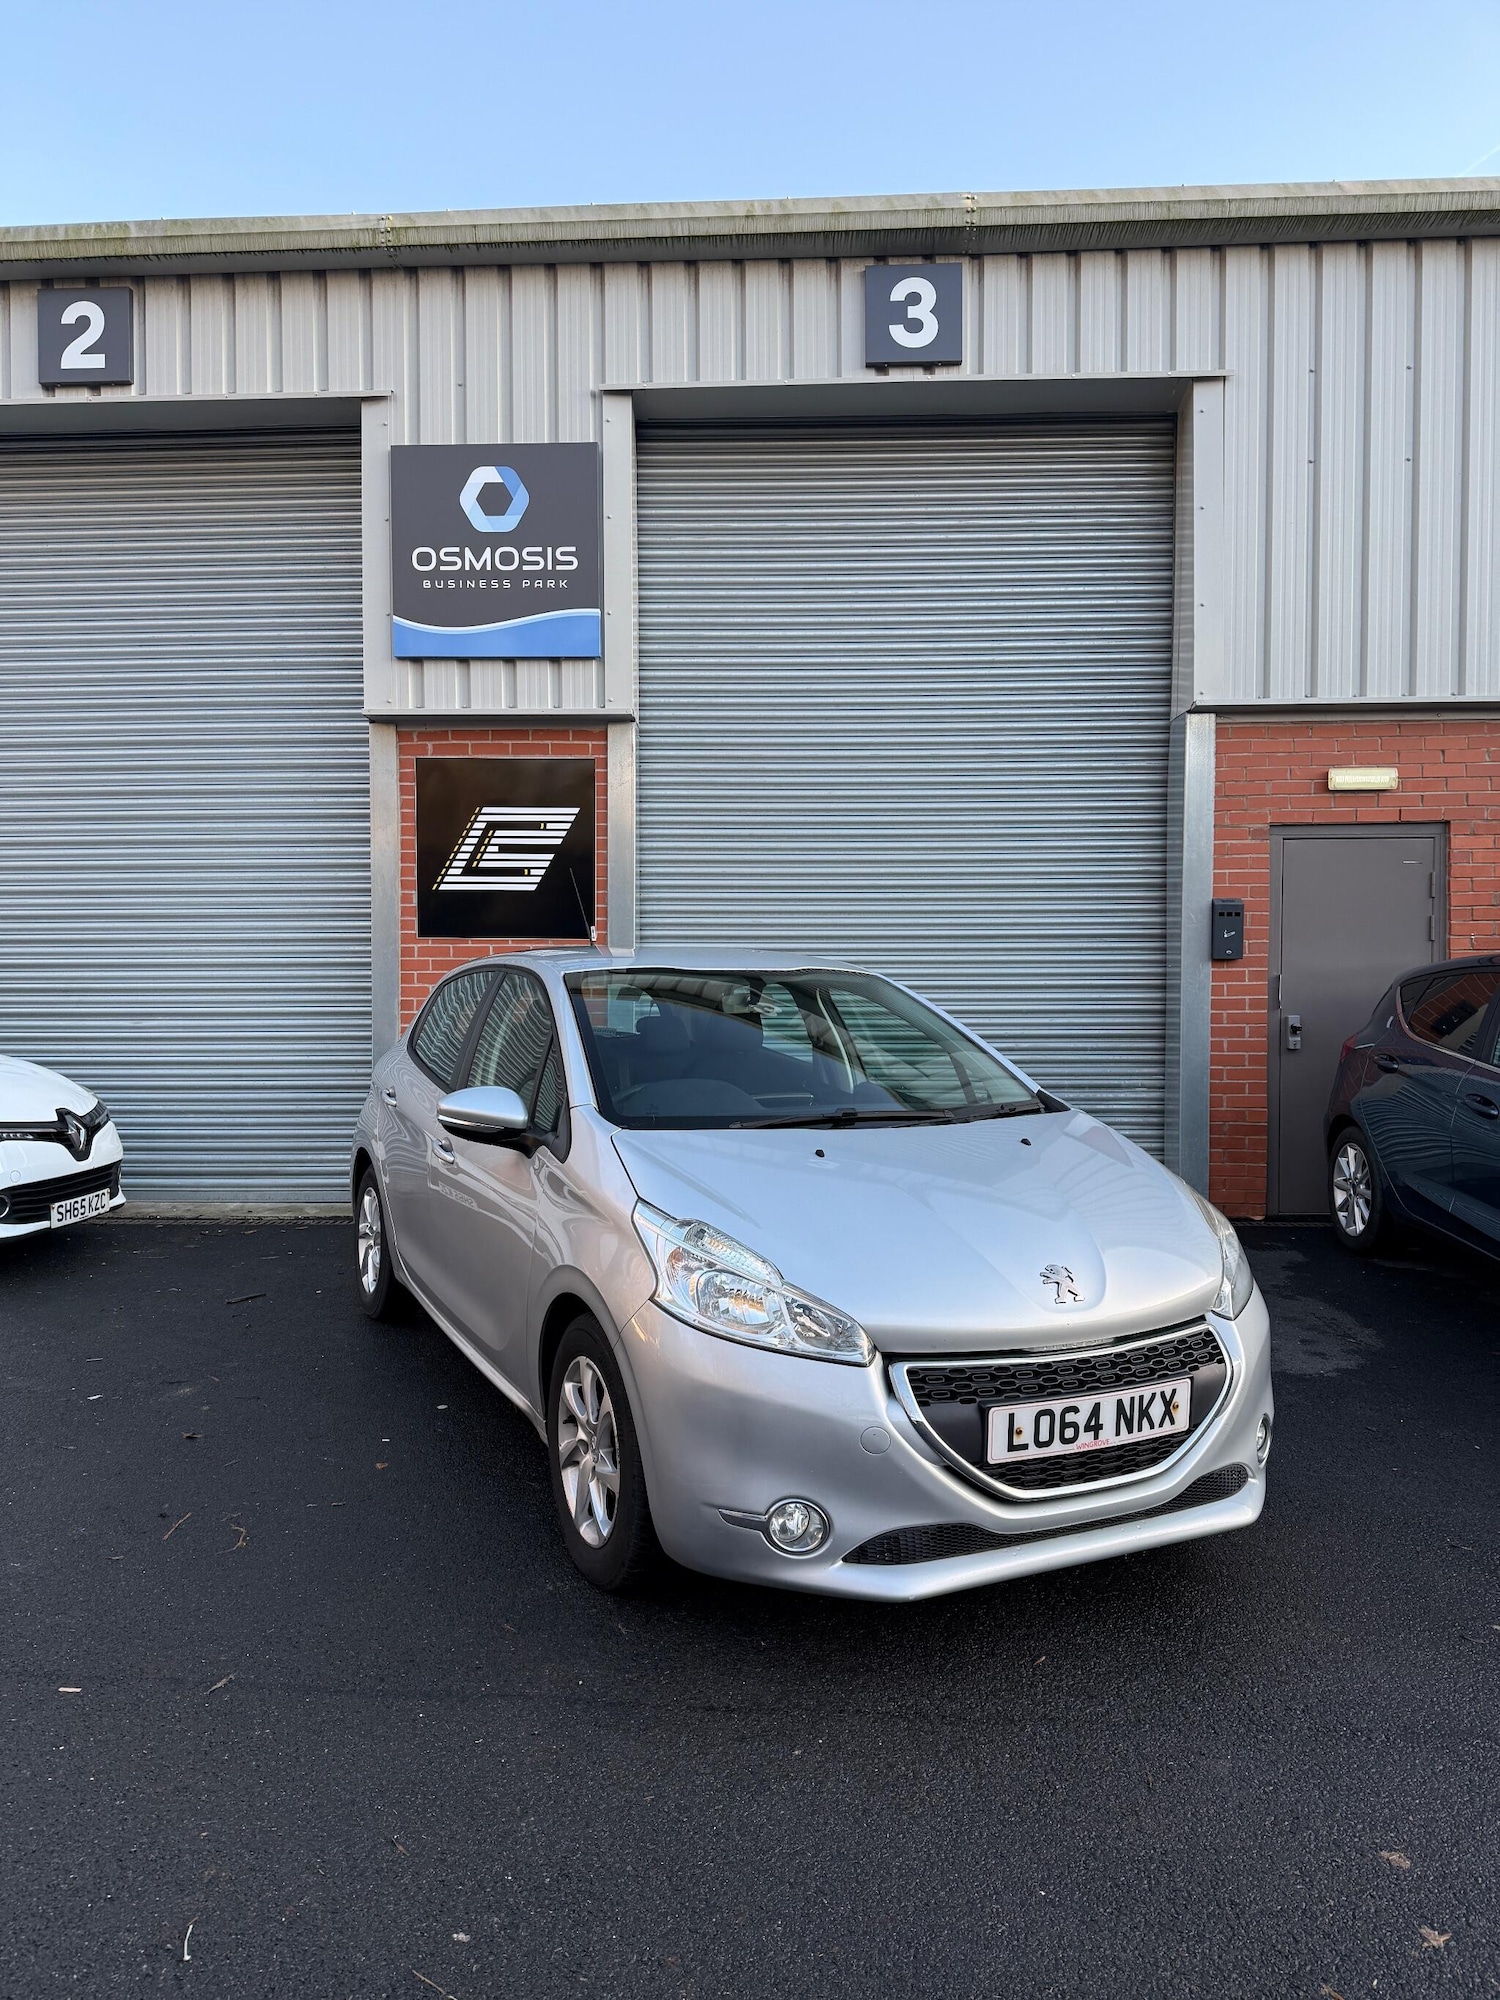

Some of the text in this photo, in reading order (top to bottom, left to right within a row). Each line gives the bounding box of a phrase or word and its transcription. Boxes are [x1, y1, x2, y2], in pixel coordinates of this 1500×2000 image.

[889, 277, 938, 348] 3
[61, 301, 105, 369] 2
[412, 546, 578, 571] OSMOSIS
[423, 579, 568, 589] BUSINESS PARK
[56, 1192, 106, 1222] SH65 KZC
[1007, 1388, 1177, 1452] LO64 NKX
[1076, 1438, 1110, 1450] WINGROVE
